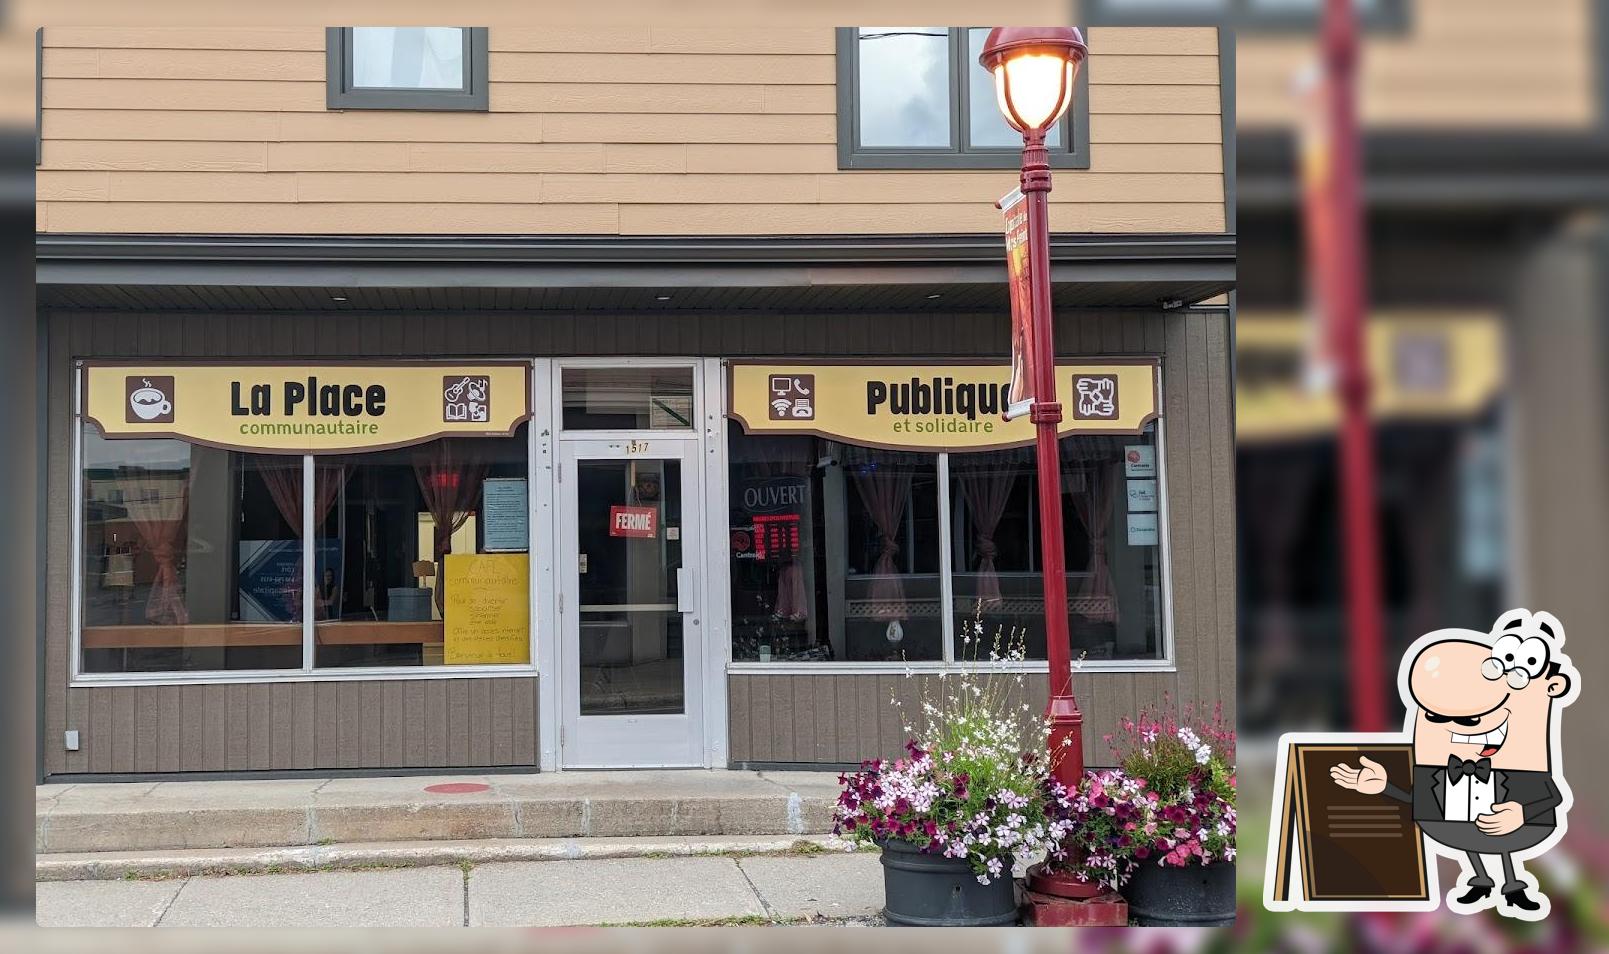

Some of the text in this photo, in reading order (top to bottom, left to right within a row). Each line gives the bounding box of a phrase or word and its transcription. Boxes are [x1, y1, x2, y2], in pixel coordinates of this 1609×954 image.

[231, 376, 386, 417] La Place
[239, 419, 379, 436] communautaire
[893, 416, 994, 434] et solidaire
[625, 442, 650, 456] 1517
[744, 484, 809, 508] OUVERT
[615, 511, 652, 531] FERMÉ
